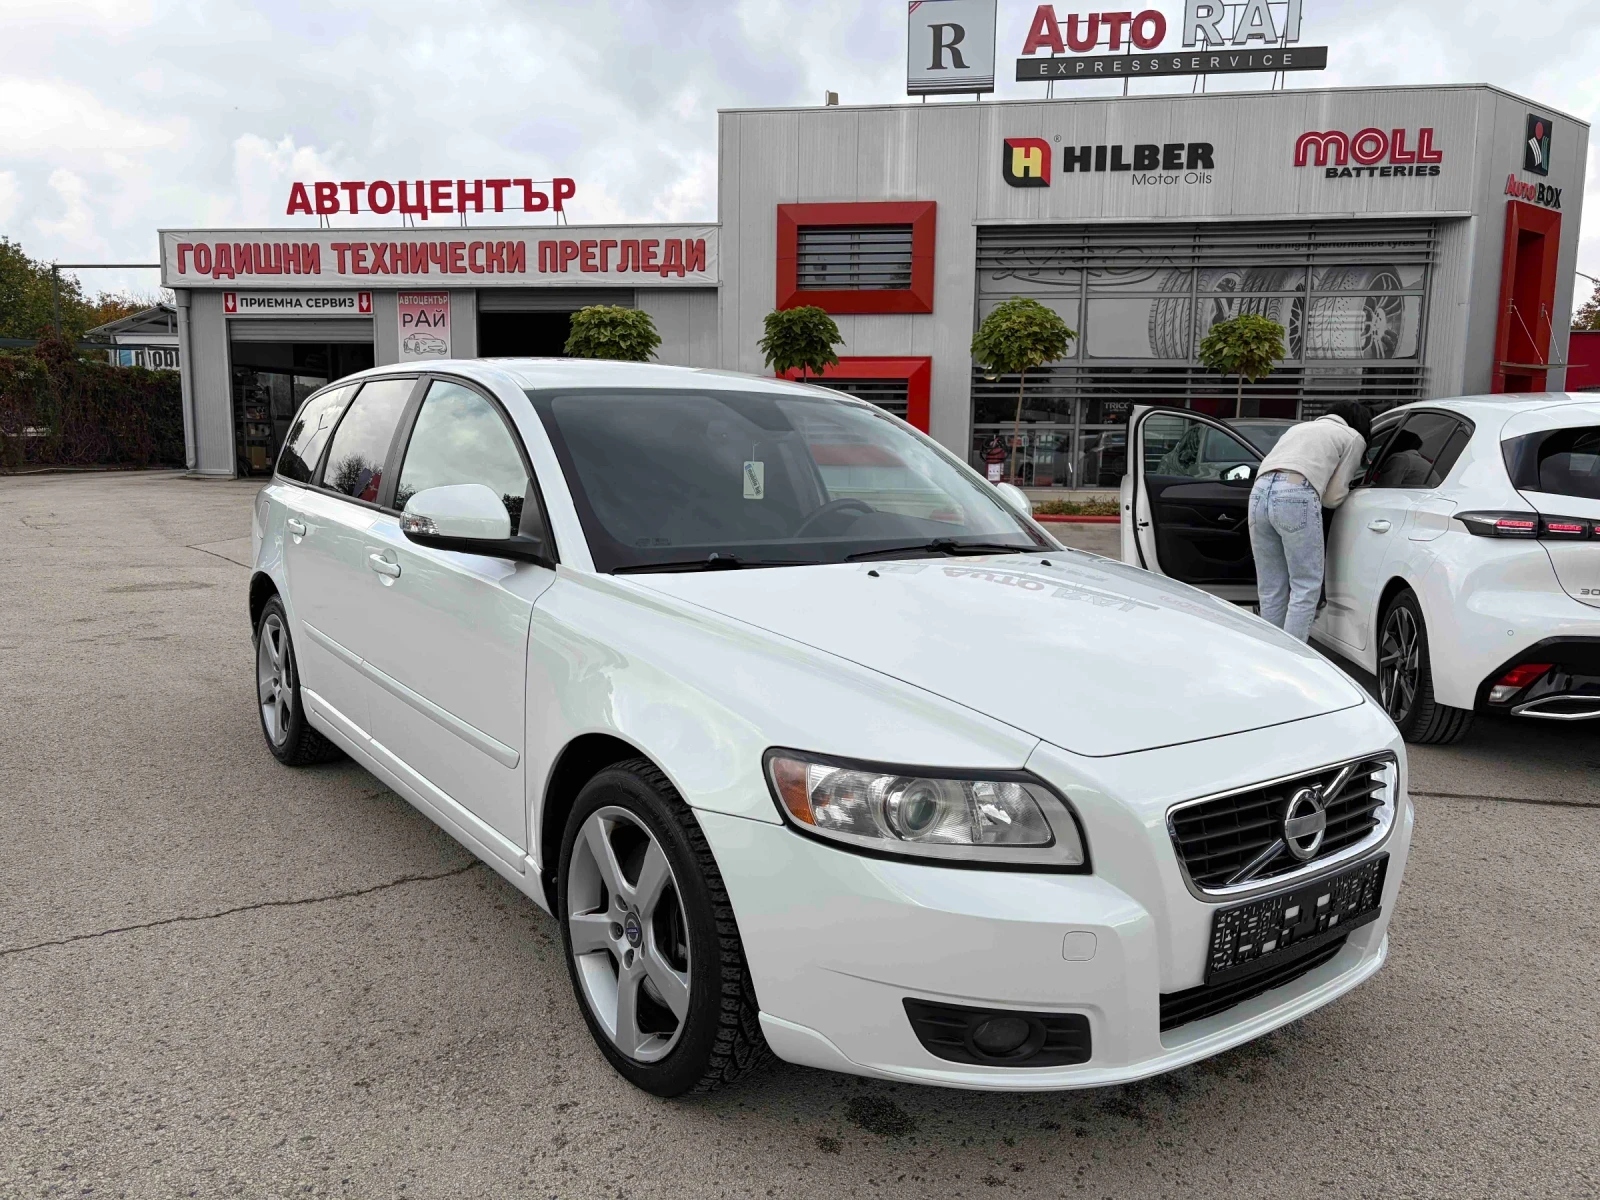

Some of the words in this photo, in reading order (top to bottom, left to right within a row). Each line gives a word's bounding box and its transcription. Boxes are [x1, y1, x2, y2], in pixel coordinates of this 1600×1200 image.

[1182, 0, 1302, 47] RAI
[926, 22, 970, 71] R
[1039, 60, 1159, 75] EXPRESS
[1172, 54, 1292, 69] SERVICE
[1063, 142, 1215, 173] HILBER
[1131, 173, 1180, 186] Motor
[1184, 172, 1213, 185] Oils
[1325, 165, 1441, 179] BATTERIES
[286, 177, 576, 221] АВТОЦЕНТЪР
[176, 242, 321, 280] ГОДИШНИ
[331, 241, 526, 275] ТЕХНИЧЕСКИ
[538, 238, 706, 278] ПРЕГЛЕДИ
[240, 297, 303, 308] ПРИЕМНА
[305, 297, 355, 308] СЕРВИЗ
[399, 295, 448, 305] АВТОЦЕНТЪР
[402, 309, 446, 328] РАЙ
